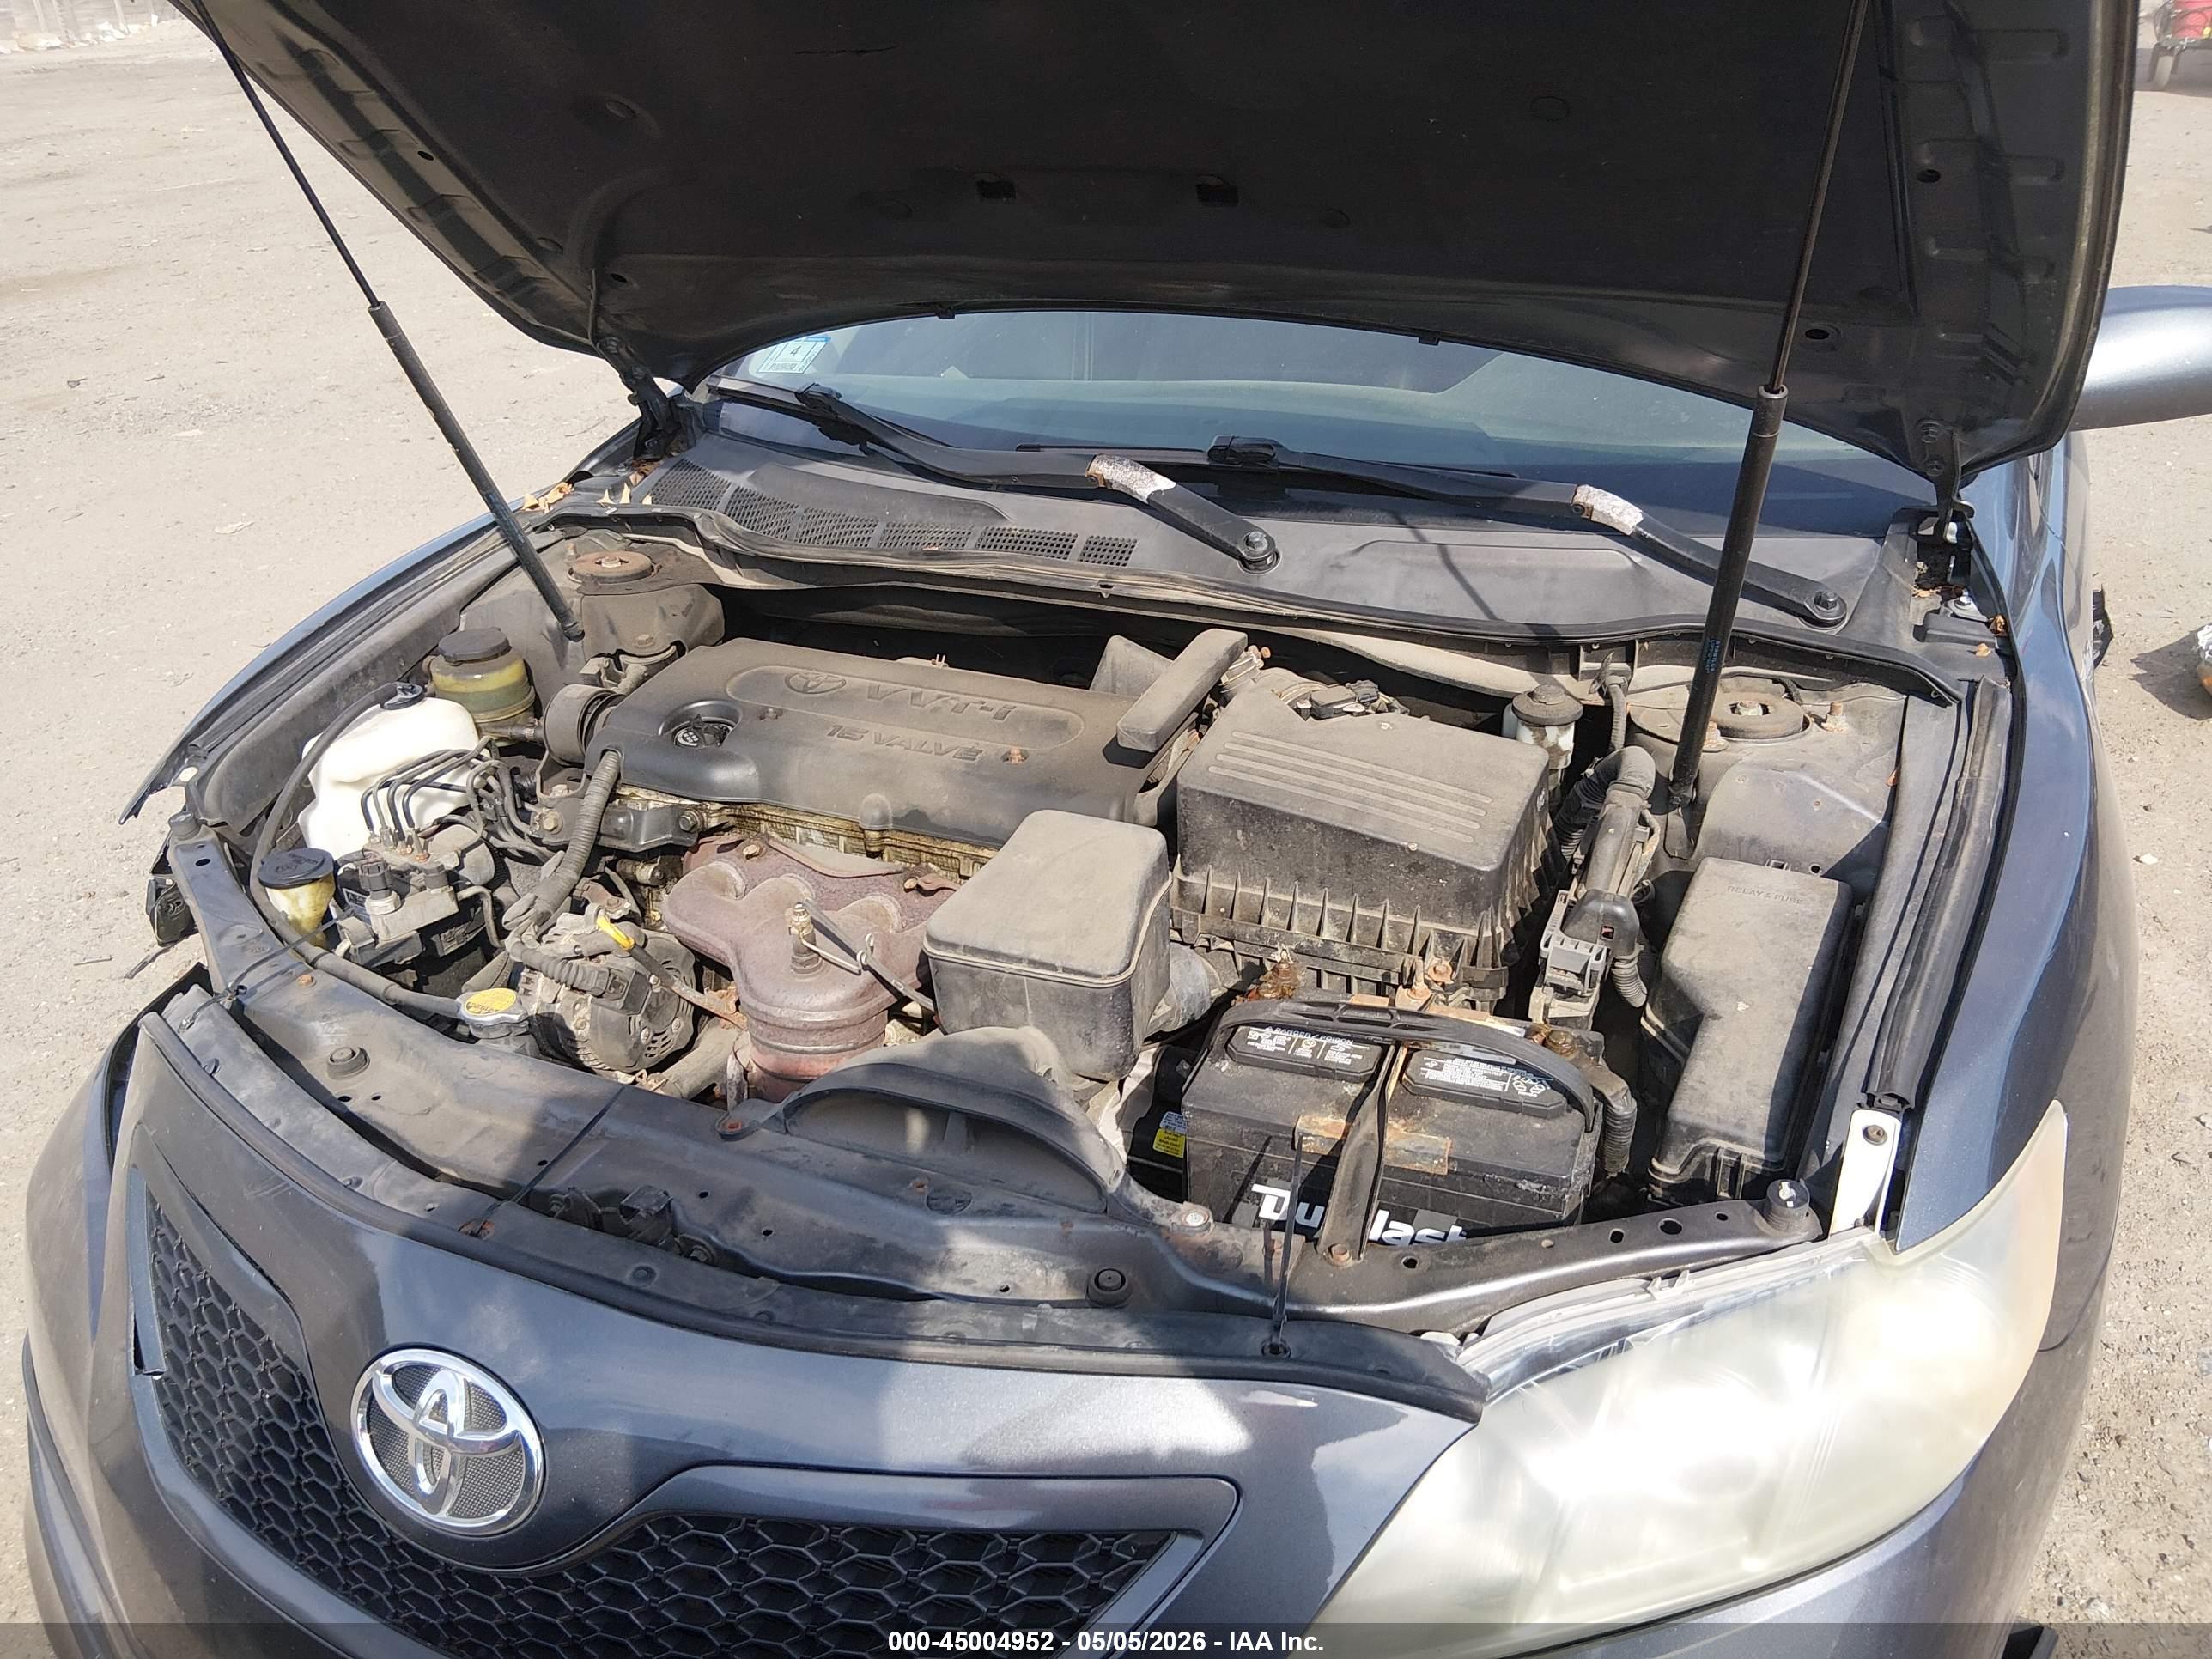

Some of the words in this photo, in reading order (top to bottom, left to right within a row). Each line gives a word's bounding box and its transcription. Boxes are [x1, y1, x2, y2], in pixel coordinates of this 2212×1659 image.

[790, 345, 802, 356] 4
[867, 683, 1016, 720] VVT-i
[826, 724, 870, 742] 16
[872, 732, 983, 762] VALVE
[1727, 885, 1765, 897] RELAY
[1274, 1027, 1311, 1038] DANGER
[1319, 1035, 1354, 1045] POISON
[1251, 1183, 1468, 1245] Dulast
